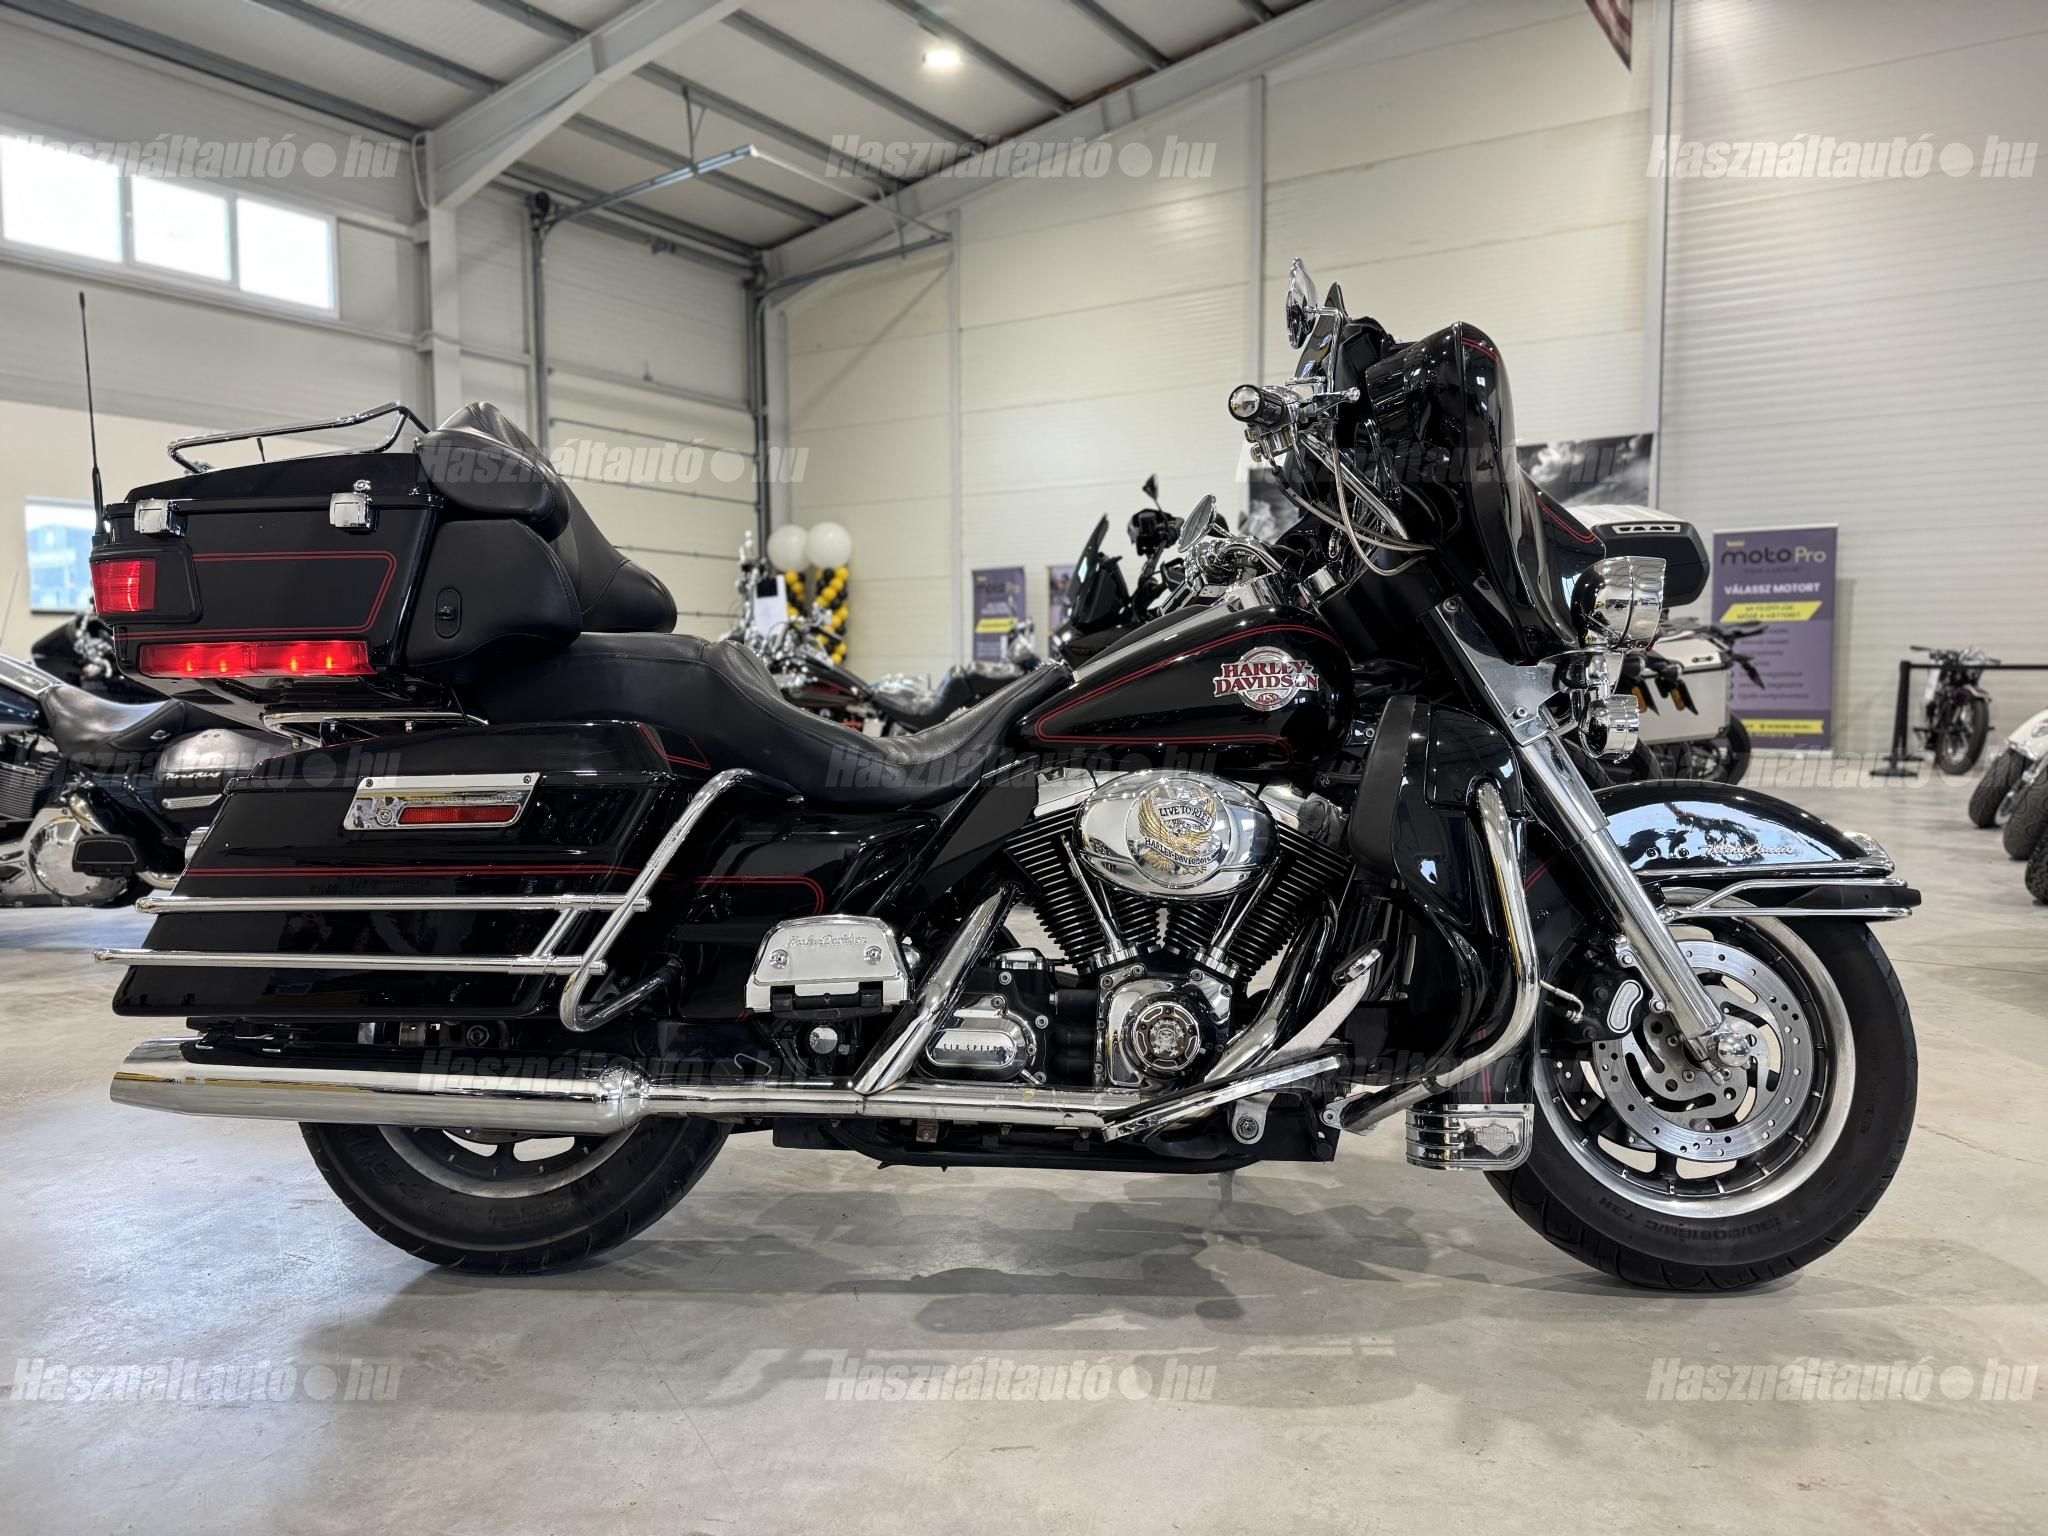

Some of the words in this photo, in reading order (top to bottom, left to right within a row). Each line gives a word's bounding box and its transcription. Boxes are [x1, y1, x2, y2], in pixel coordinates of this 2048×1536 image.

[1772, 582, 1821, 593] MOTORT
[1215, 673, 1319, 695] DAVIDSON
[1158, 805, 1180, 817] LIVE
[1180, 805, 1192, 815] TO
[1192, 808, 1211, 825] RIDE
[943, 1043, 960, 1052] SIX
[966, 1044, 998, 1053] SPEED
